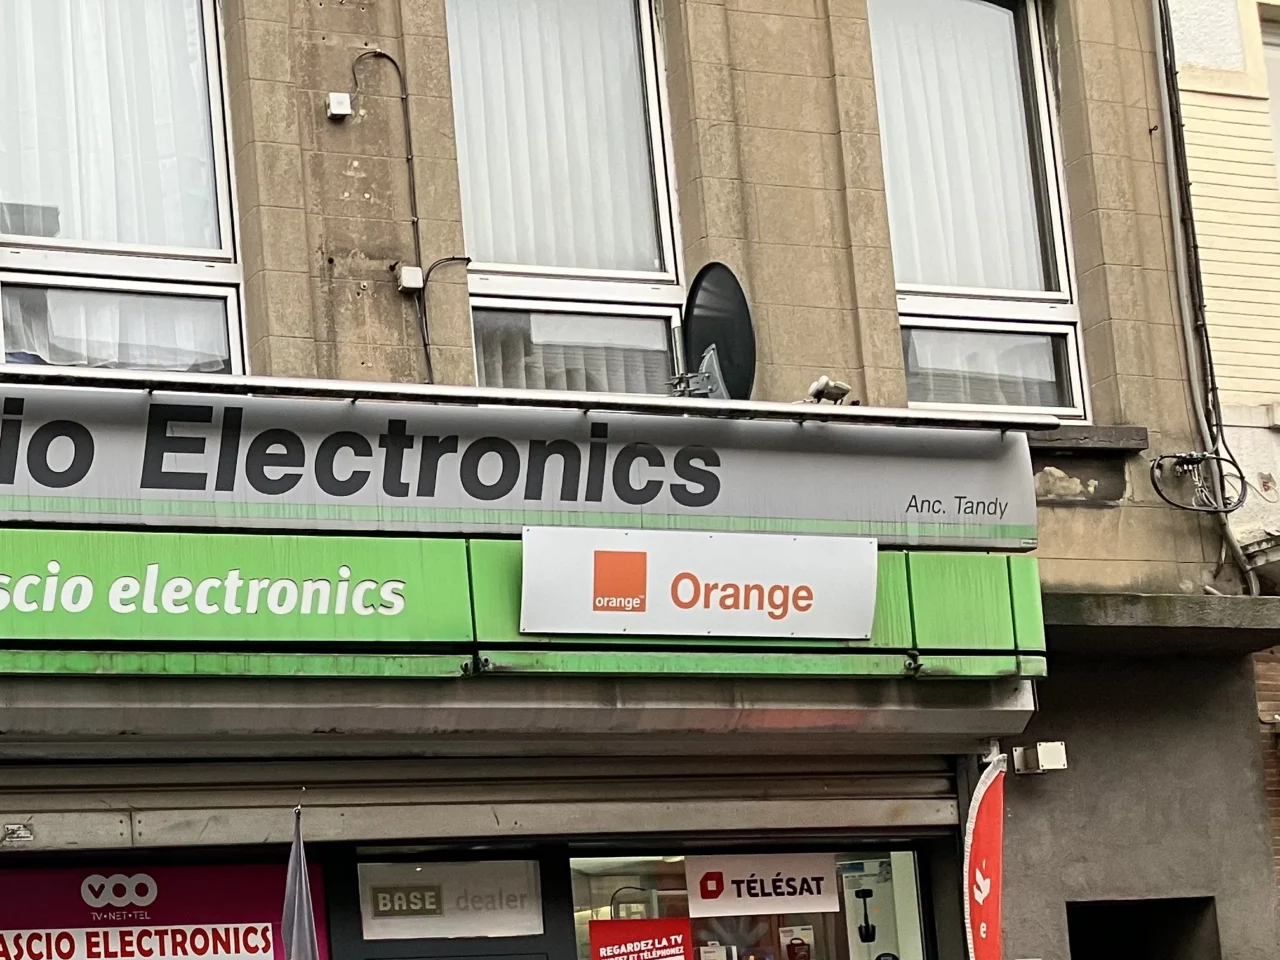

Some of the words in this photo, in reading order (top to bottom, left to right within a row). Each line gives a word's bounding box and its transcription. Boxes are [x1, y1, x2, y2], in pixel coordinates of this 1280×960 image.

[140, 403, 721, 507] Electronics
[905, 495, 947, 516] Anc.
[954, 496, 1009, 521] Tandy
[108, 563, 407, 616] electronics
[670, 572, 814, 620] Orange
[596, 595, 641, 612] orange
[731, 872, 825, 899] TÉLÉSAT
[377, 891, 437, 911] BASE
[456, 888, 528, 912] dealer
[85, 925, 272, 959] ELECTRONICS
[599, 940, 653, 958] REGARDEZ
[655, 937, 669, 948] LA
[670, 934, 683, 945] TV
